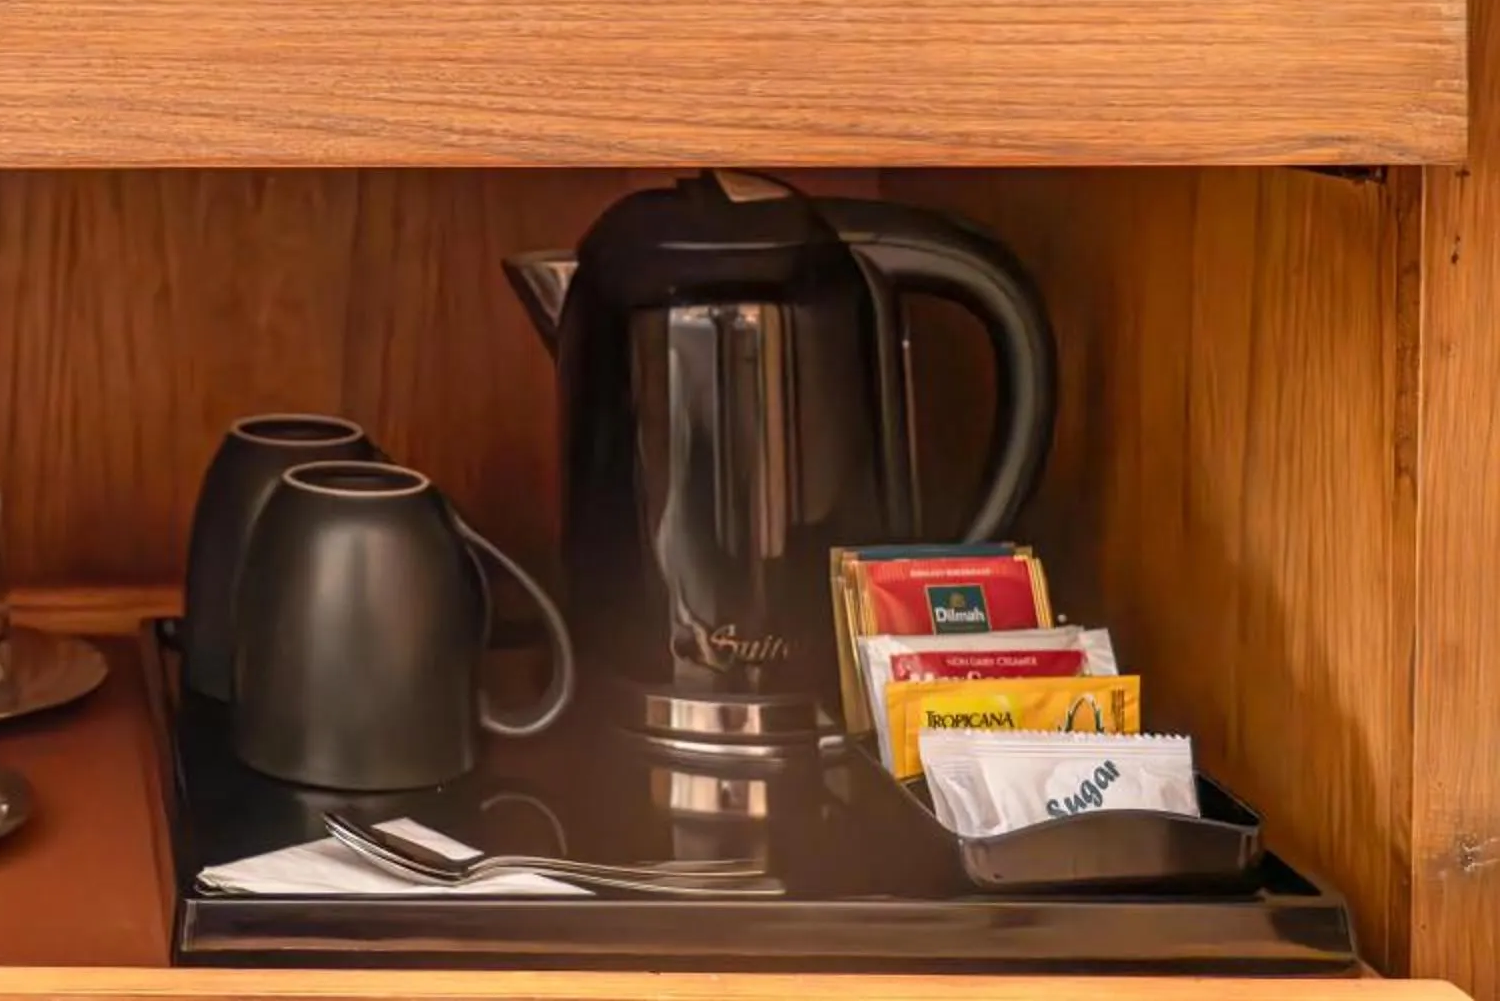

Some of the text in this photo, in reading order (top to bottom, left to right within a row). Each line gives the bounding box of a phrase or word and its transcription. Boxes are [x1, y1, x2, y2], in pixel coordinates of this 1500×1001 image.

[934, 606, 985, 623] Dilmah
[925, 710, 1015, 729] TROPICANA
[1046, 760, 1120, 818] Sugar
